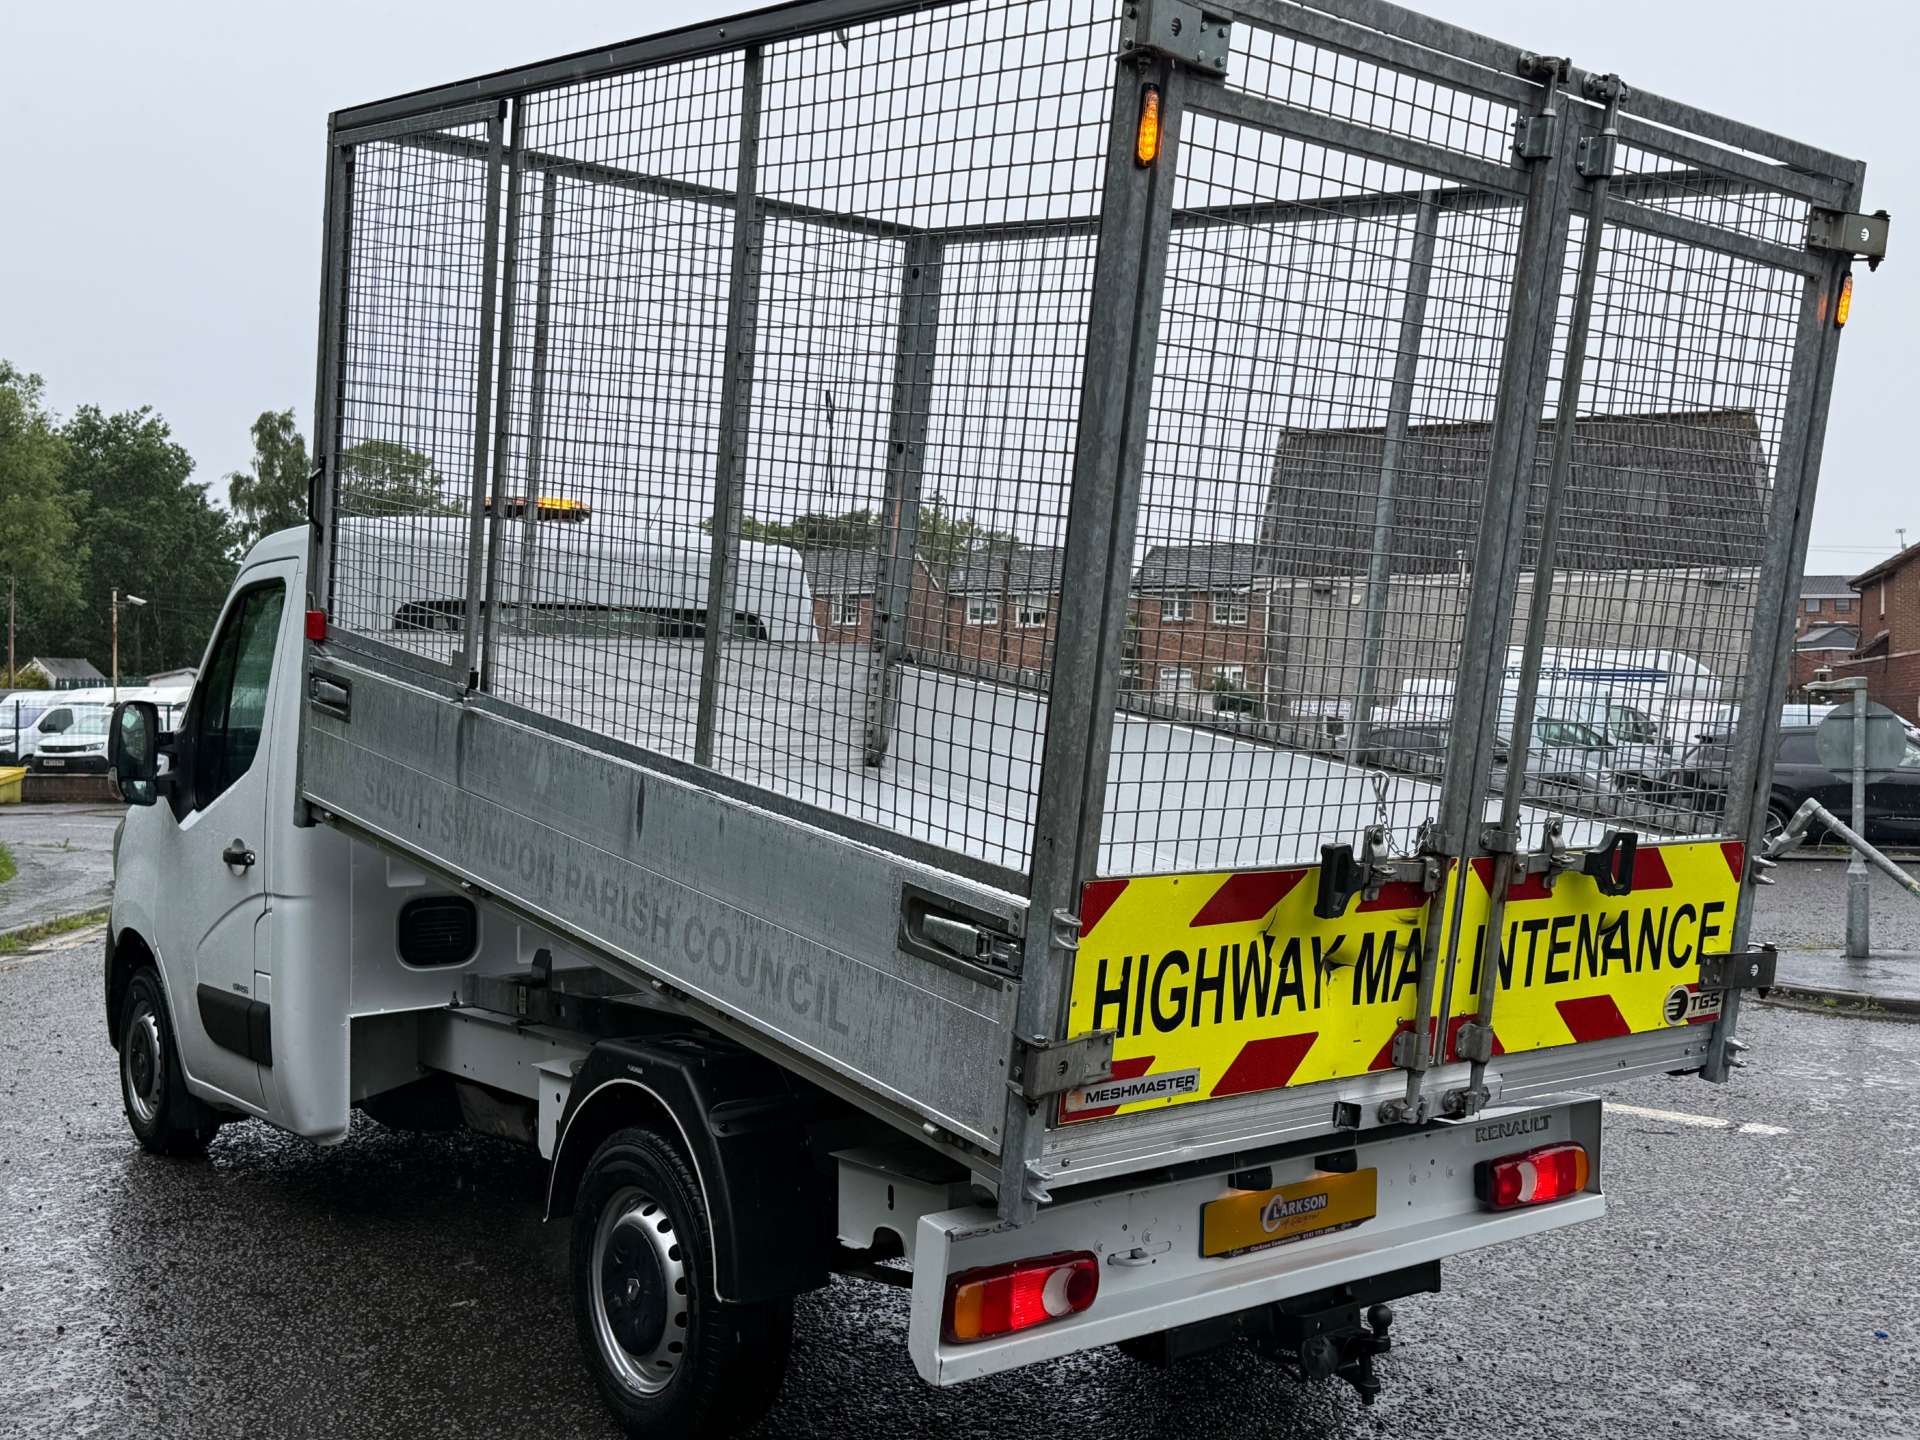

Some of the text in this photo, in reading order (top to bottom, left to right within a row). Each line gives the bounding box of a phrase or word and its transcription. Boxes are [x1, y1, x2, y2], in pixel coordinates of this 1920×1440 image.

[565, 863, 673, 946] PARISH
[683, 914, 850, 1037] COUNCIL
[1092, 934, 1346, 1039] HIGHWAY
[1085, 1074, 1195, 1104] MESHMASTER
[1475, 1115, 1552, 1142] RENAULT
[1262, 1194, 1328, 1233] CLARKSON
